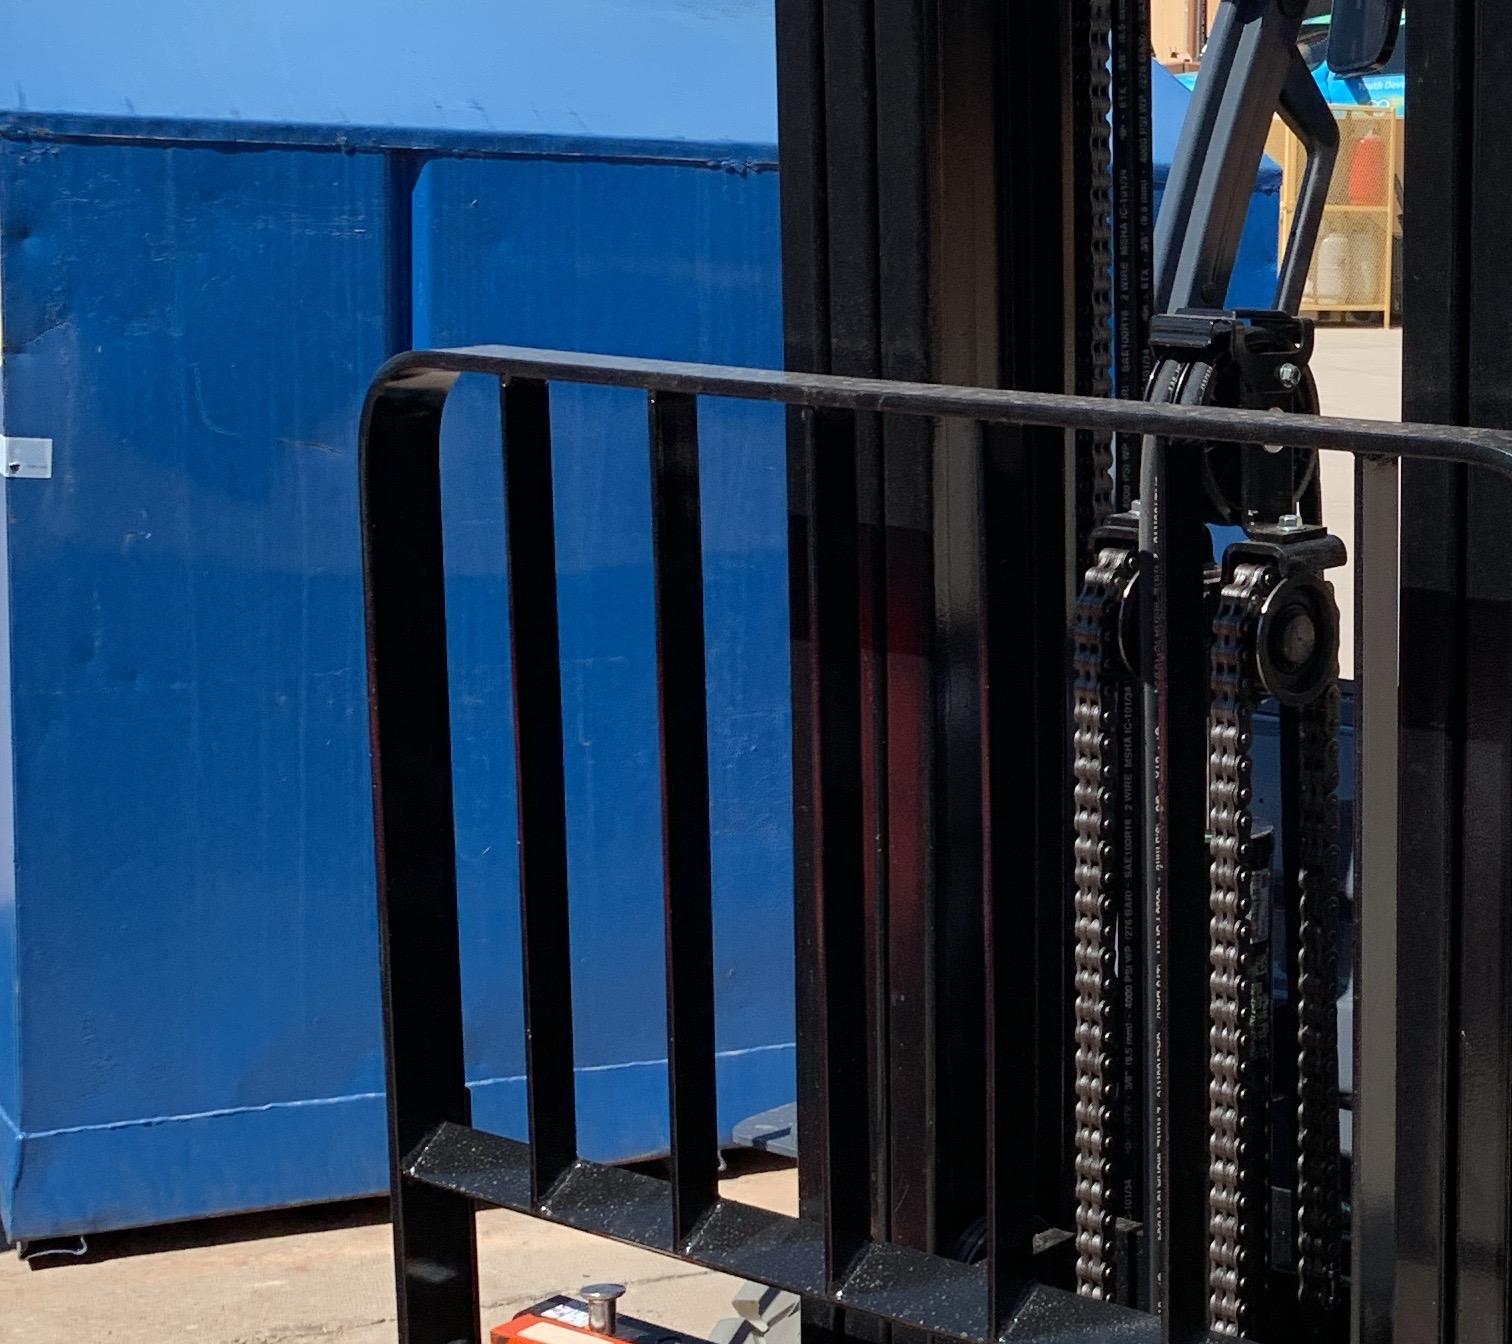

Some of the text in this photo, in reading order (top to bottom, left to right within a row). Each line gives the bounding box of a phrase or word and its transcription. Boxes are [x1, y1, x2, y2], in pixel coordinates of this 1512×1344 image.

[1122, 685, 1133, 734] IC-101/34
[1123, 736, 1133, 768] MSHA
[1123, 775, 1133, 802] WIRE
[1123, 818, 1133, 879] SAE100R16
[1124, 985, 1134, 1010] 4000
